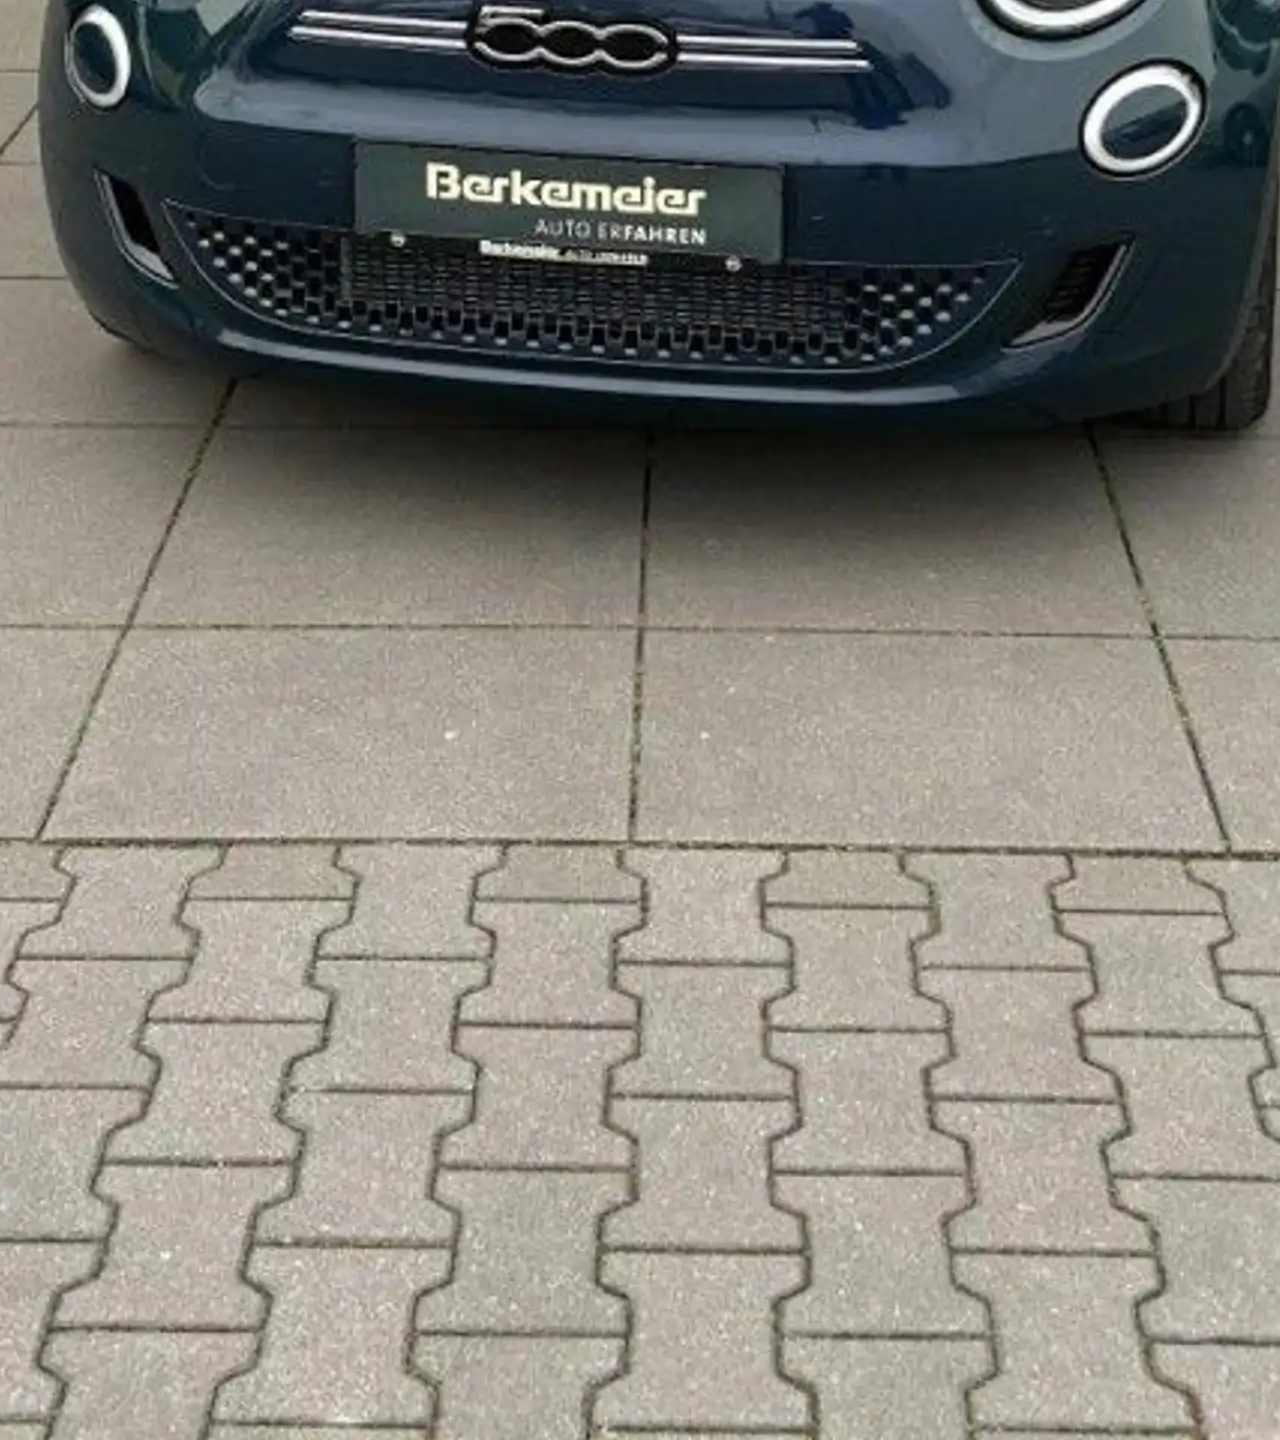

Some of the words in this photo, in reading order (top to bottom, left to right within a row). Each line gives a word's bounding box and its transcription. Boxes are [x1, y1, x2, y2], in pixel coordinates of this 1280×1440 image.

[474, 5, 669, 69] 500
[426, 162, 707, 216] Berkemeier
[535, 218, 591, 240] AUTO
[597, 222, 707, 246] ERFAHREN
